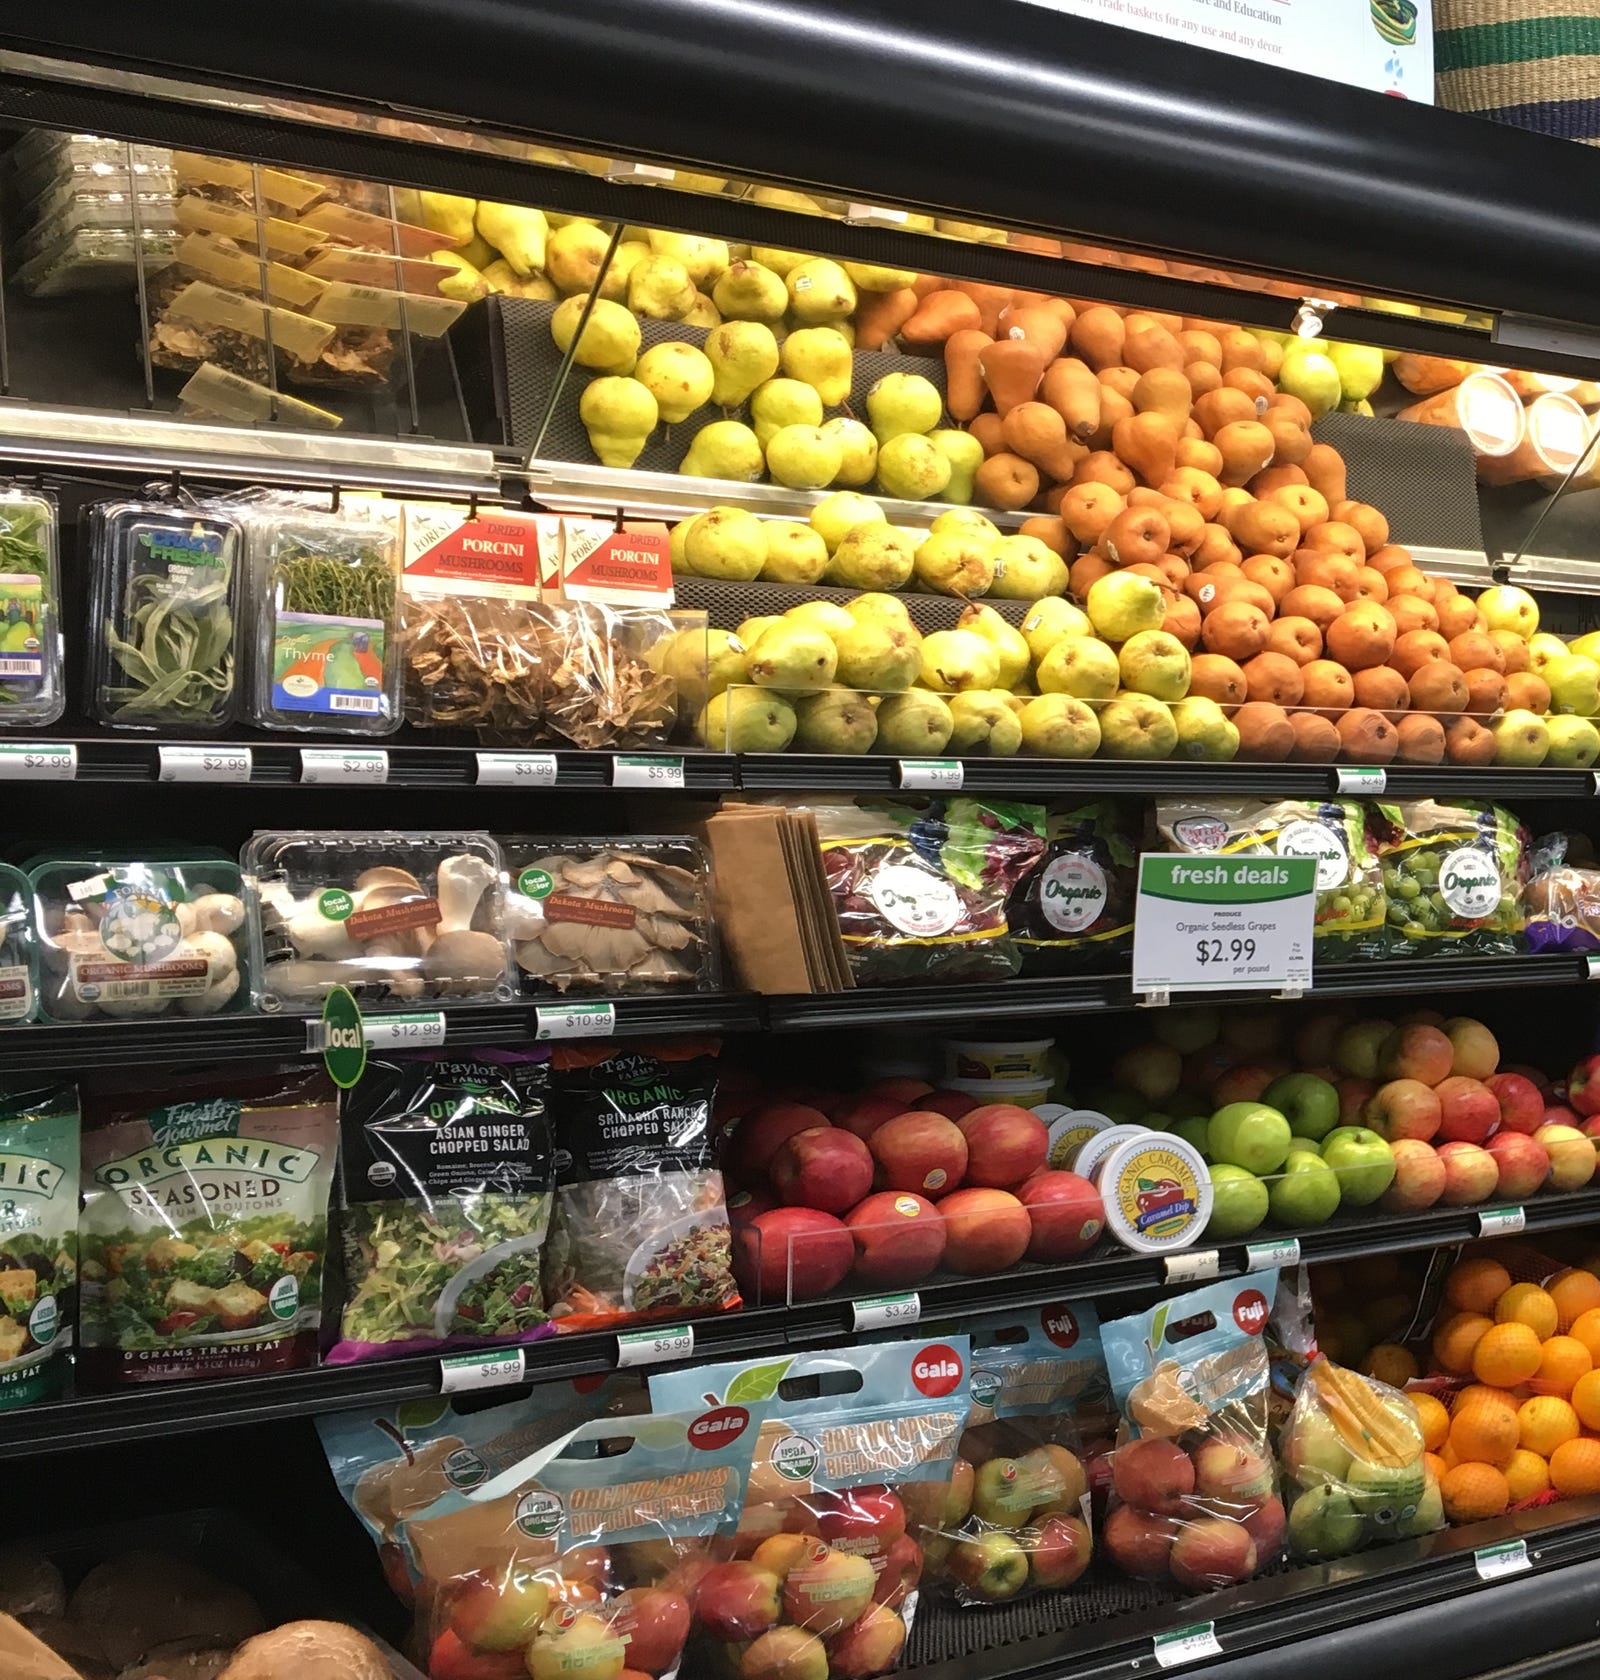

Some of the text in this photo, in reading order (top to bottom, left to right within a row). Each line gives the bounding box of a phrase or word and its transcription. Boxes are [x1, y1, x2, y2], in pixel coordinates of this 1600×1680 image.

[1234, 3, 1282, 26] Education
[1127, 3, 1163, 23] baskets
[1165, 15, 1180, 27] for
[1182, 19, 1200, 34] any
[1202, 25, 1217, 37] use
[1219, 27, 1237, 42] and
[1239, 34, 1256, 49] any
[488, 523, 526, 538] DRIED
[462, 538, 525, 557] PORCINI
[630, 534, 661, 546] DRIED
[438, 553, 524, 574] MUSHROOMS
[609, 548, 660, 566] PORCINI
[591, 564, 658, 582] MUSHROOMS
[282, 647, 335, 663] Thyme
[24, 754, 72, 769] $2.99
[203, 757, 248, 771] $2.99
[342, 760, 385, 774] $2.99
[514, 763, 554, 777] $3.99
[647, 766, 682, 780] $5.99
[930, 769, 962, 781] $1.99
[524, 875, 547, 886] local
[1171, 864, 1289, 885] fresh deals
[1444, 872, 1497, 894] Organic
[1045, 879, 1102, 905] Organic
[323, 896, 347, 907] local
[549, 896, 634, 916] Dakota Mushrooms
[350, 902, 436, 925] Dakota Mushrooms
[1175, 921, 1277, 934] Organic Seedless Grapes
[1196, 938, 1256, 966] $2.99
[81, 961, 205, 976] ORGANIC MUSHROOMS
[1233, 965, 1270, 975] per pound
[565, 1014, 612, 1028] $10.99
[327, 1022, 361, 1049] local
[391, 1024, 442, 1038] $12.99
[435, 1060, 498, 1076] Taylor
[452, 1076, 488, 1084] FARMS
[602, 1084, 685, 1106] ORGANIC
[166, 1098, 240, 1125] Fresh
[662, 1106, 698, 1119] RANCH
[435, 1124, 525, 1140] ASIAN GINGER
[602, 1122, 659, 1139] CHOPPED
[430, 1138, 530, 1154] CHOPPED SALAD
[104, 1144, 301, 1185] ORGANIC
[131, 1178, 281, 1205] SEASONED
[1120, 1156, 1146, 1213] ORGANIC
[1140, 1201, 1190, 1226] Caramel Dip
[1501, 1216, 1523, 1227] $2.99
[1272, 1247, 1298, 1260] $3.49
[884, 1303, 918, 1318] $3.29
[1237, 1301, 1265, 1322] Fuji
[1047, 1315, 1072, 1335] Fuji
[124, 1340, 280, 1360] 0 GRAMS TRANS FAT
[654, 1337, 691, 1353] $5.99
[22, 1365, 41, 1379] FAT
[148, 1364, 168, 1374] NET
[481, 1361, 521, 1377] $5.99
[914, 1359, 959, 1379] Gala
[693, 1416, 744, 1435] Gala
[823, 1412, 956, 1455] ORGANIC APPLES
[780, 1448, 807, 1457] USDA
[570, 1466, 731, 1510] ORGANIC APPLES
[1499, 1551, 1526, 1564] $4.99
